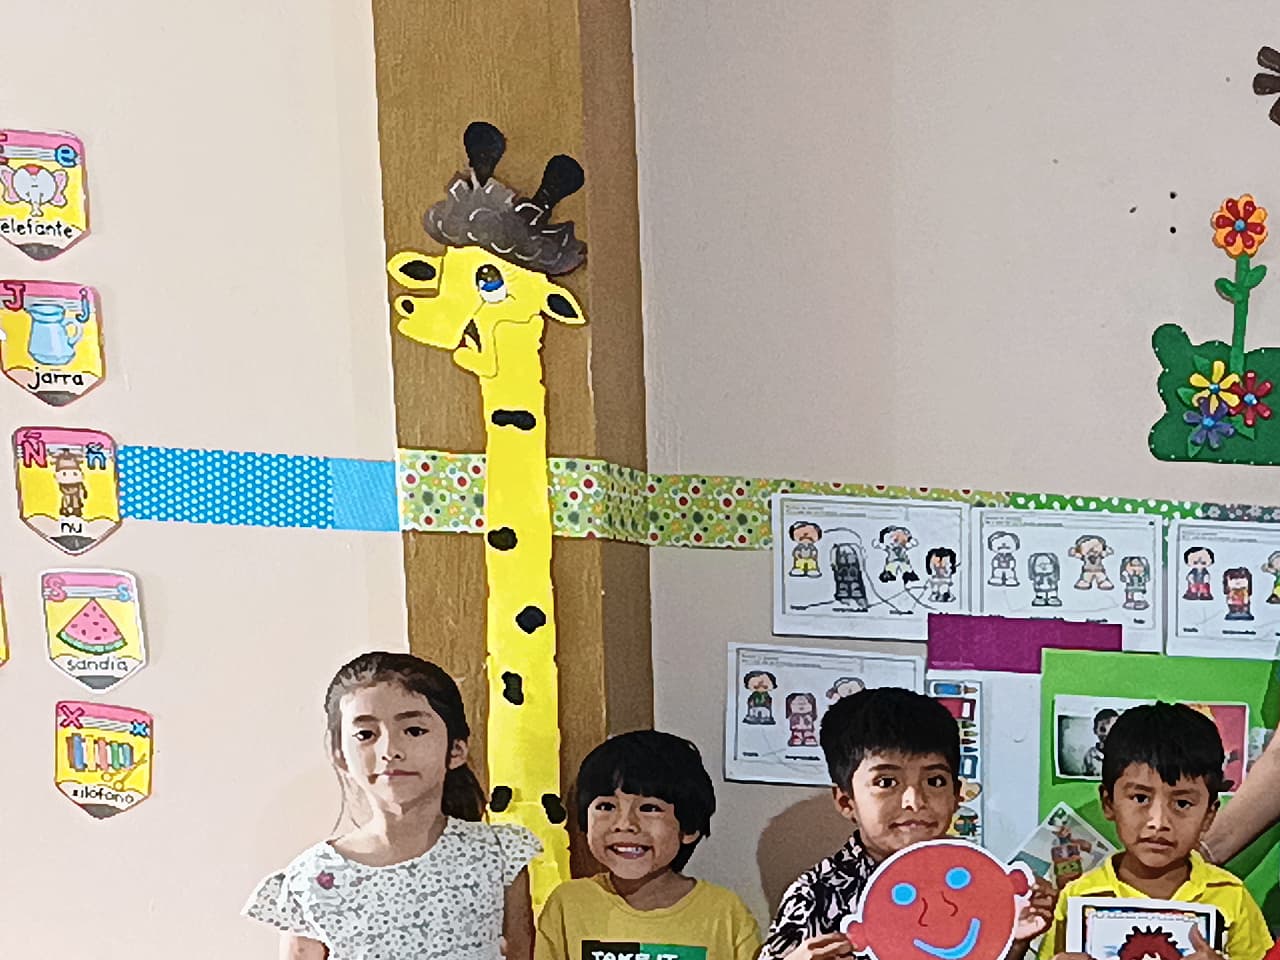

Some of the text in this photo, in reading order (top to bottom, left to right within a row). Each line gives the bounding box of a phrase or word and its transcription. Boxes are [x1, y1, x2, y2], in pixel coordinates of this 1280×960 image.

[1, 218, 73, 239] elefante
[4, 282, 26, 312] J
[27, 366, 84, 391] jarra
